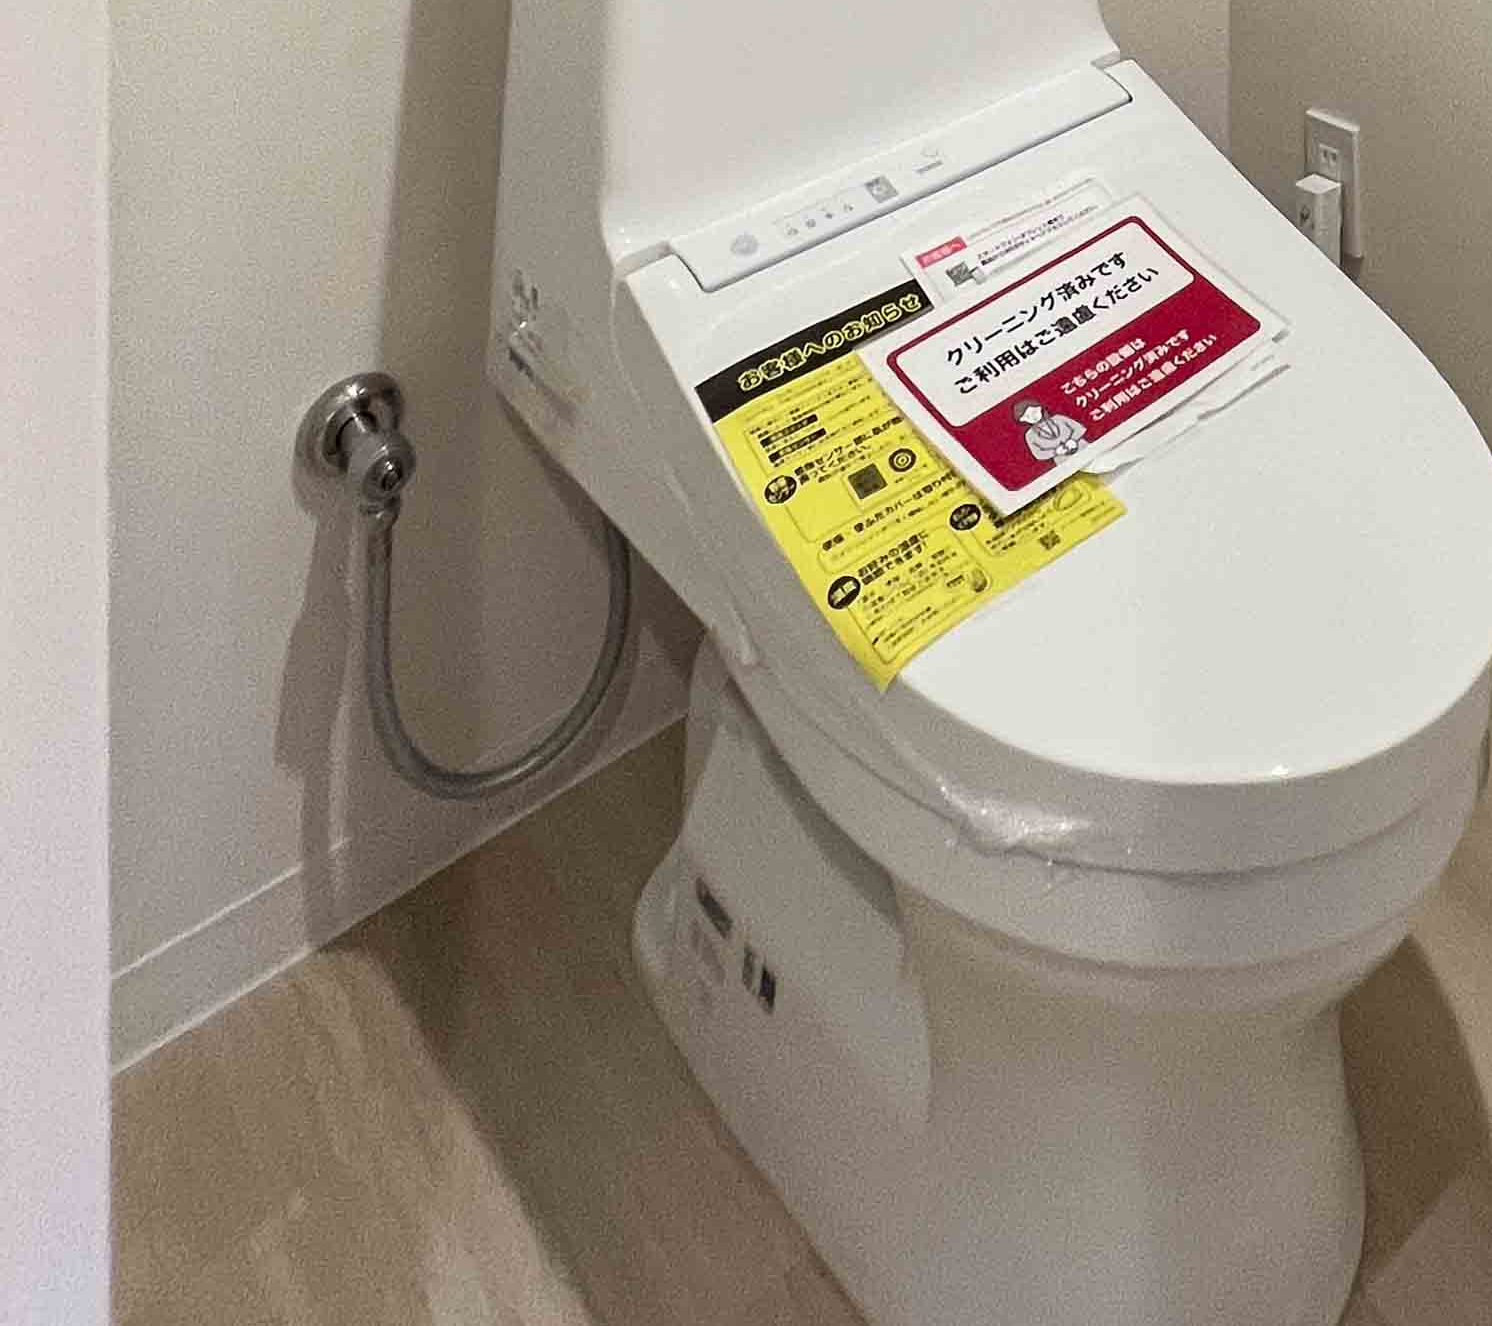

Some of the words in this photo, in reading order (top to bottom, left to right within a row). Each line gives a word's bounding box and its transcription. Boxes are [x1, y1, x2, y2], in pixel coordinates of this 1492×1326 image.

[737, 293, 922, 391] お客様へのお知らせ
[947, 251, 1126, 366] クリーニング済みです
[953, 267, 1160, 395] ご利用はご遠慮ください
[1075, 328, 1190, 408] クリーニング済みです
